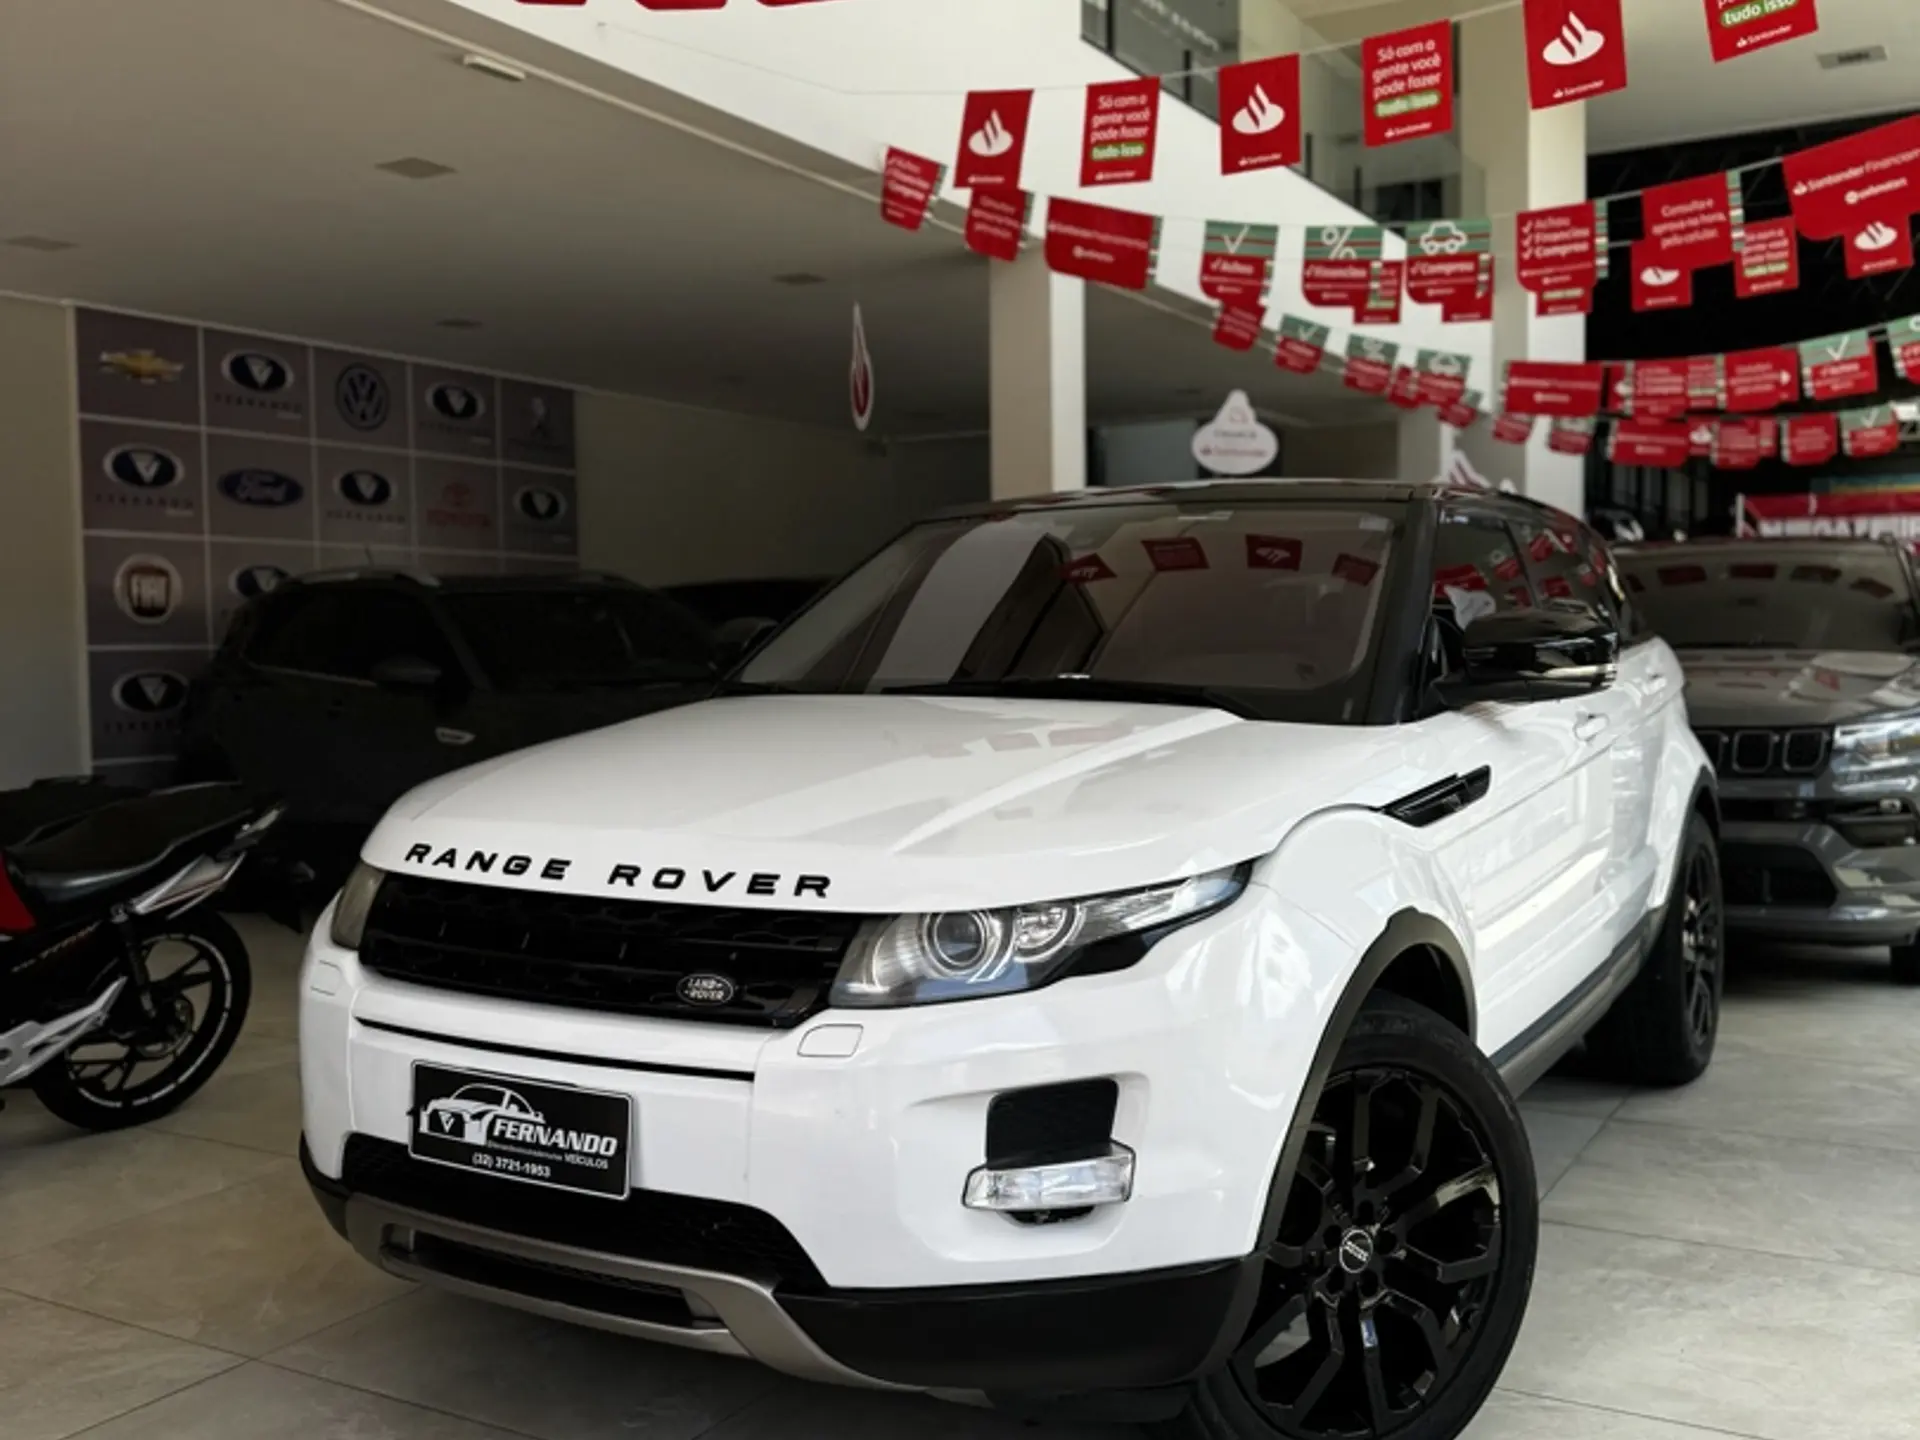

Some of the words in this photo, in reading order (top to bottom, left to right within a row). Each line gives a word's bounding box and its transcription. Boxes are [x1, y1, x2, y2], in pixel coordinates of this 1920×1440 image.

[1723, 4, 1761, 26] tudo
[1747, 24, 1793, 44] Santander
[1377, 45, 1395, 63] Só
[1396, 41, 1424, 58] com
[1372, 62, 1409, 84] gente
[1411, 51, 1441, 71] você
[1373, 79, 1405, 101] pode
[1407, 72, 1442, 89] fazer
[1098, 95, 1113, 110] Só
[1114, 96, 1139, 108] com
[1091, 112, 1123, 128] gente
[1125, 106, 1151, 122] você
[1090, 126, 1118, 144] pode
[1119, 123, 1150, 138] fazer
[1807, 165, 1865, 192] Santander
[404, 843, 572, 880] RANGE
[607, 864, 831, 899] ROVER
[493, 1117, 618, 1157] FERNANDO
